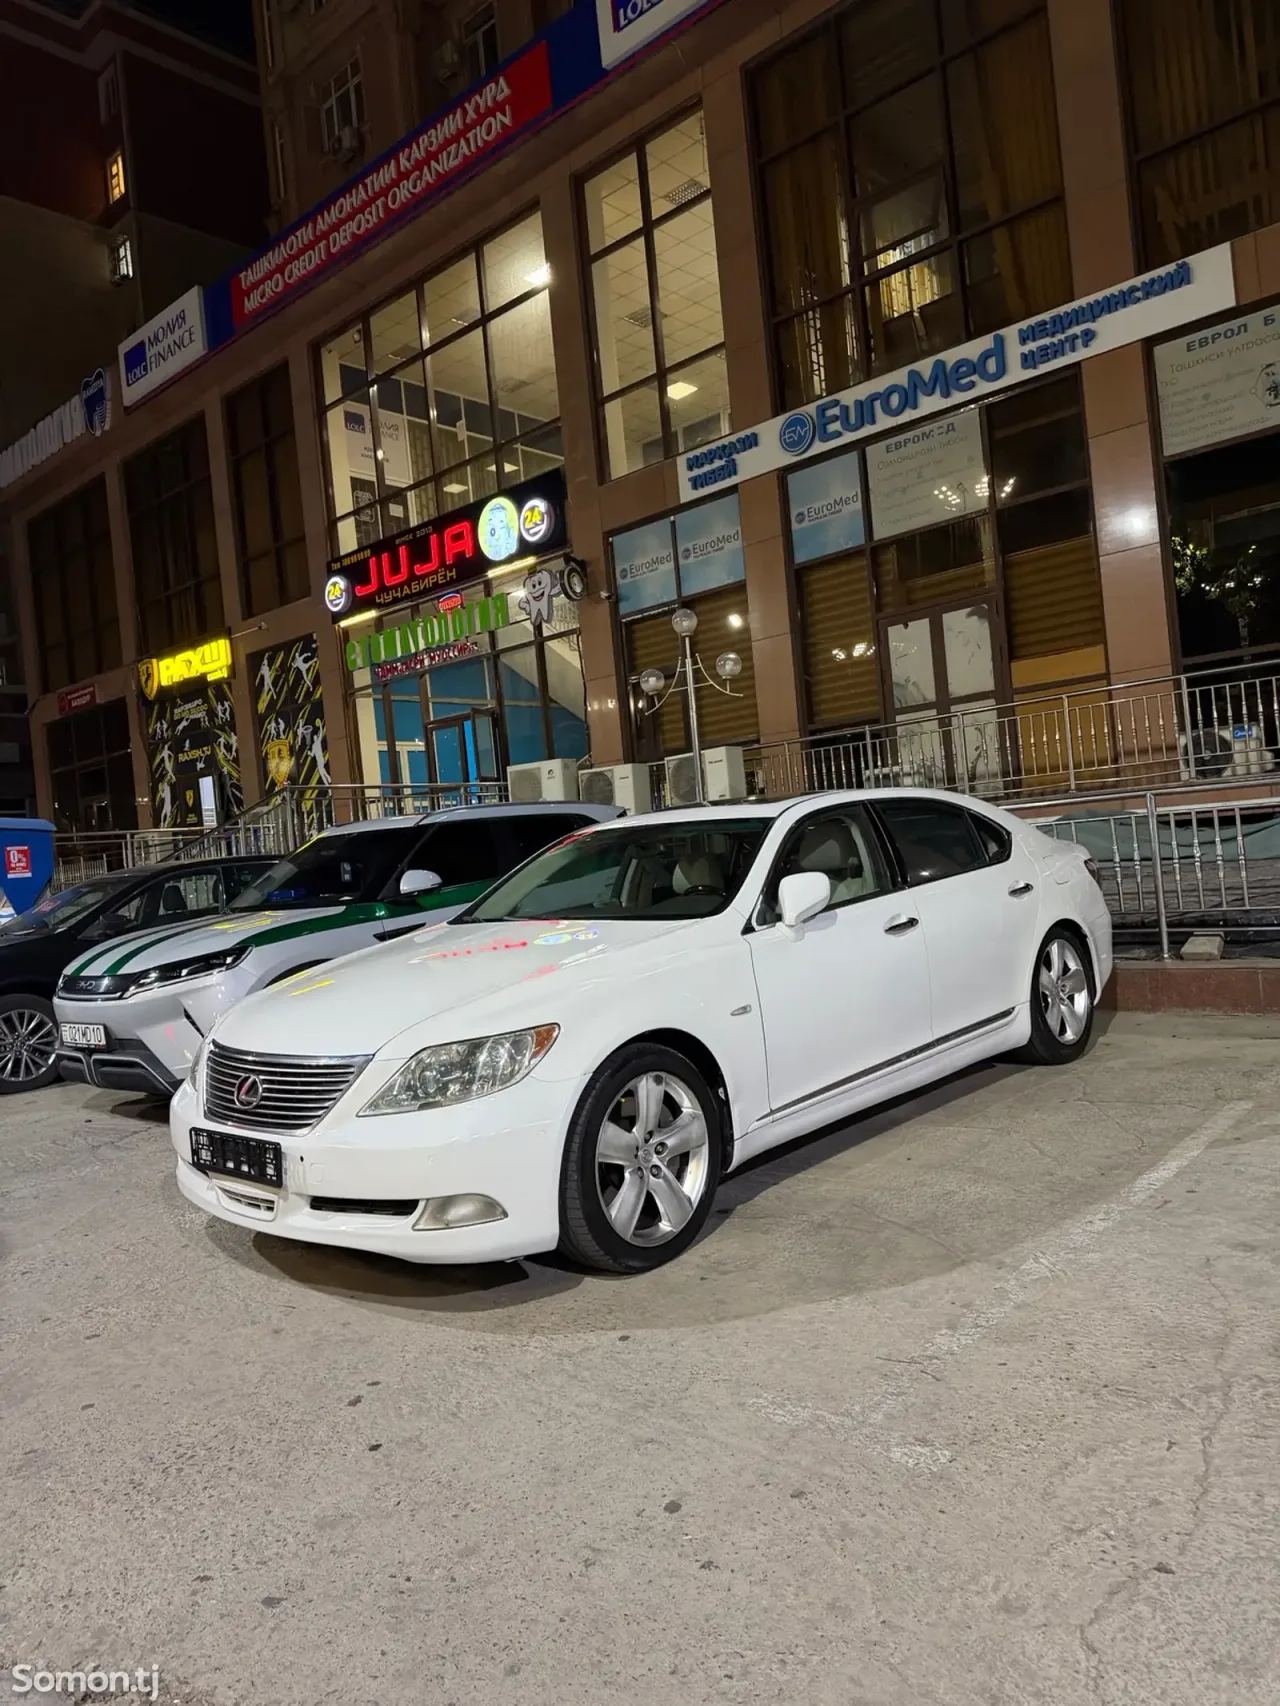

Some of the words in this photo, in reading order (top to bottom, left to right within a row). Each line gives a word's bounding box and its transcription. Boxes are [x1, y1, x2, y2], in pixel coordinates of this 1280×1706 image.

[619, 0, 664, 28] LOL
[243, 275, 284, 314] MICRO
[283, 240, 327, 284] CREDIT
[328, 200, 386, 253] DEPOSIT
[387, 104, 513, 210] ORGANIZATION
[239, 223, 314, 290] ТАШКИЛОТИ
[1018, 261, 1192, 346] МЕДИЦИНСКИЙ
[147, 309, 187, 351] МОЛИЯ
[148, 325, 196, 372] FINANCE
[1020, 328, 1096, 370] ЦЕНТР
[128, 361, 147, 384] LOLC
[816, 333, 1007, 443] EuroMed
[686, 432, 758, 471] МАРКАЗИ
[525, 506, 542, 529] 24
[806, 491, 859, 519] EuroMed
[354, 520, 473, 597] JUJA
[692, 530, 740, 555] EuroMed
[629, 551, 672, 575] EuroMed
[328, 583, 342, 600] 24
[375, 568, 457, 604] ЧУЧАБИРЁН
